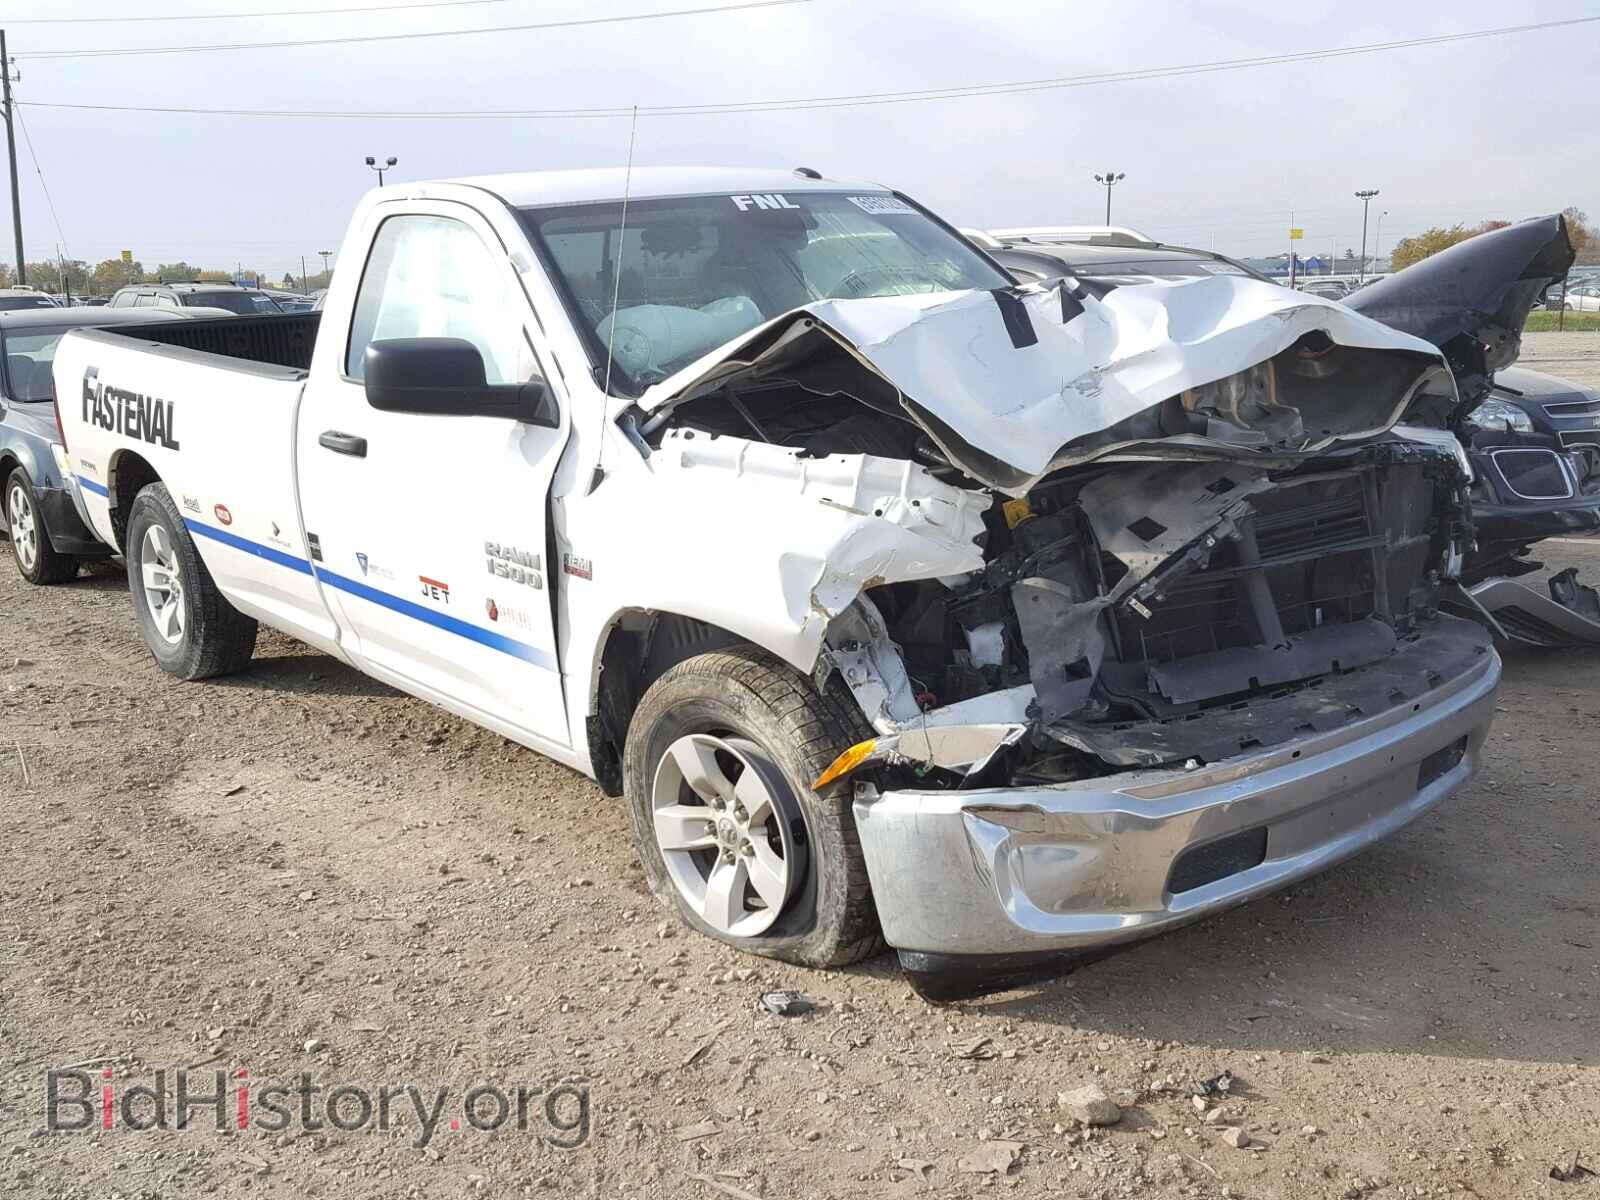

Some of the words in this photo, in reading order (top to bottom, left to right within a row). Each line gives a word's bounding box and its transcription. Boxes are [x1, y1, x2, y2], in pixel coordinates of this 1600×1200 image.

[730, 194, 800, 211] FNL
[82, 366, 180, 451] FASTENAL
[484, 541, 541, 571] RAM
[487, 558, 543, 590] 1500
[421, 584, 449, 604] JET
